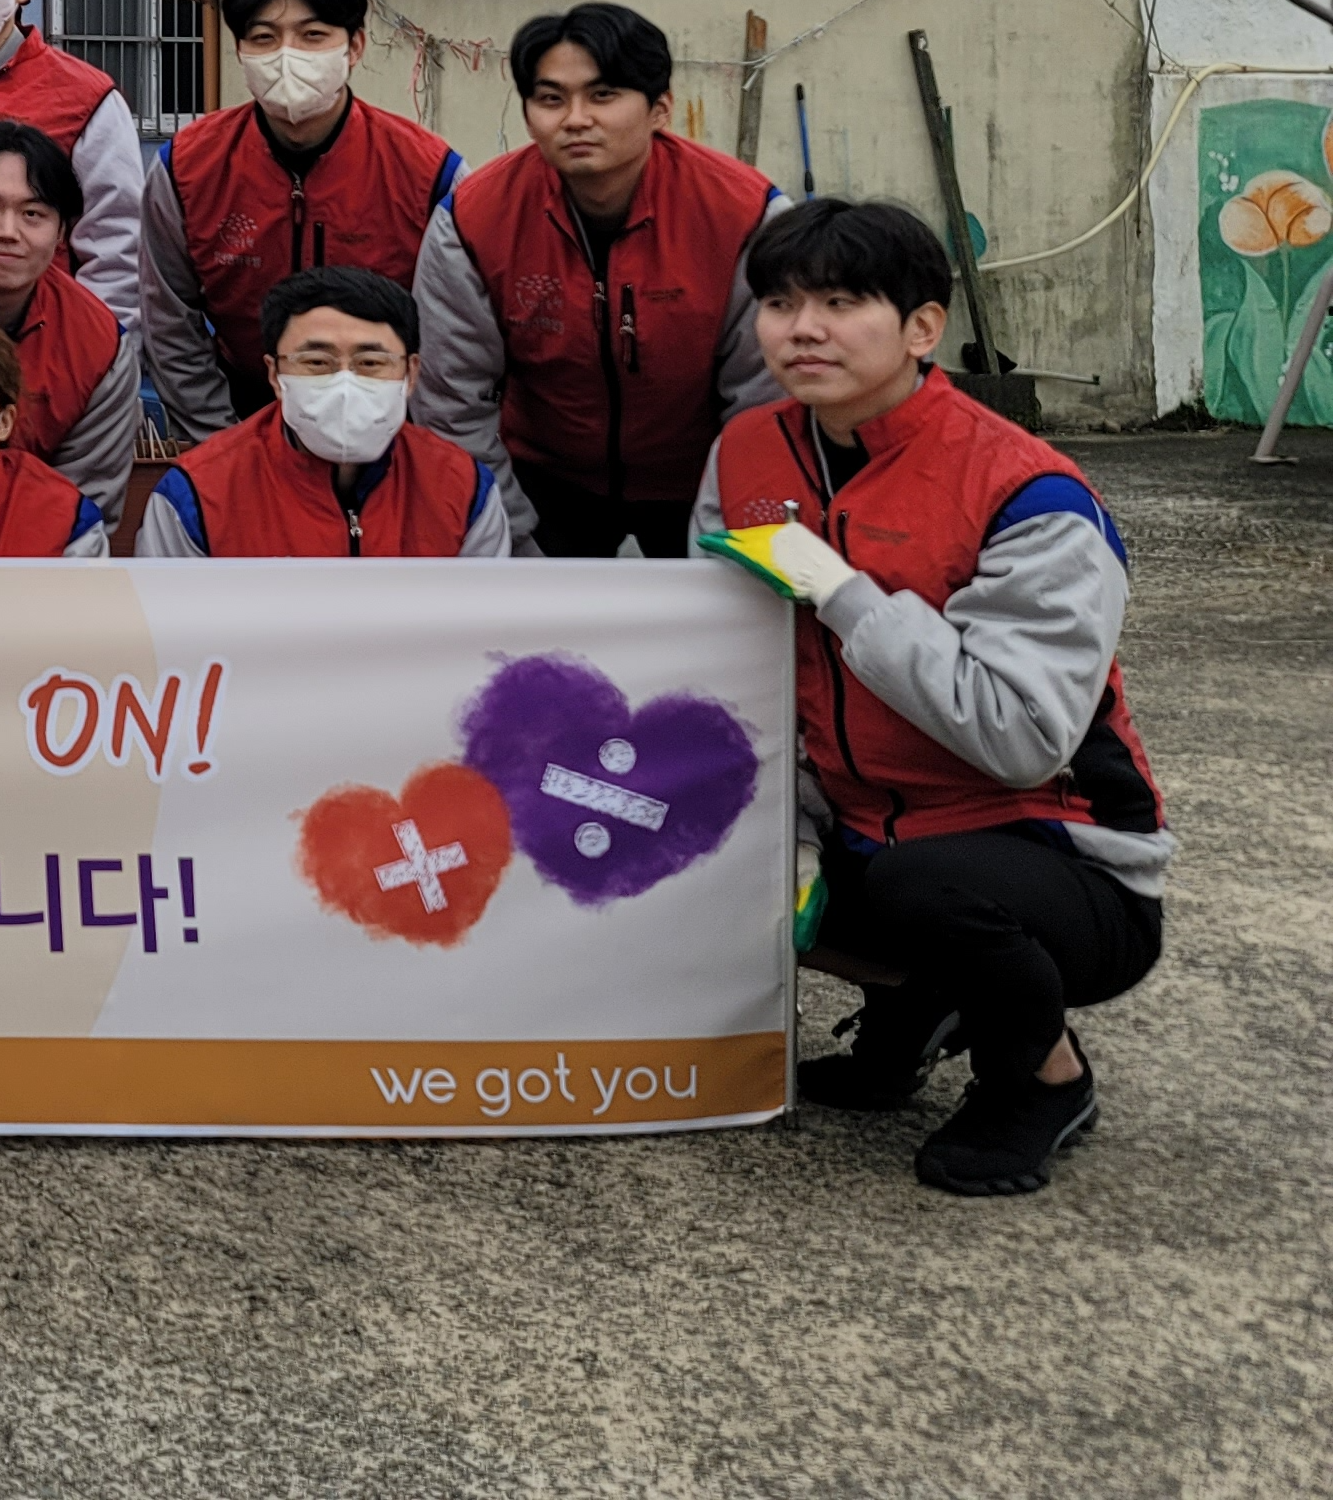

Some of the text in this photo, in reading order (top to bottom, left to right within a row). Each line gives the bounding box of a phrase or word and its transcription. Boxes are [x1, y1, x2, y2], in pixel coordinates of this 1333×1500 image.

[27, 662, 223, 776] ON!
[370, 1052, 699, 1117] we got you
